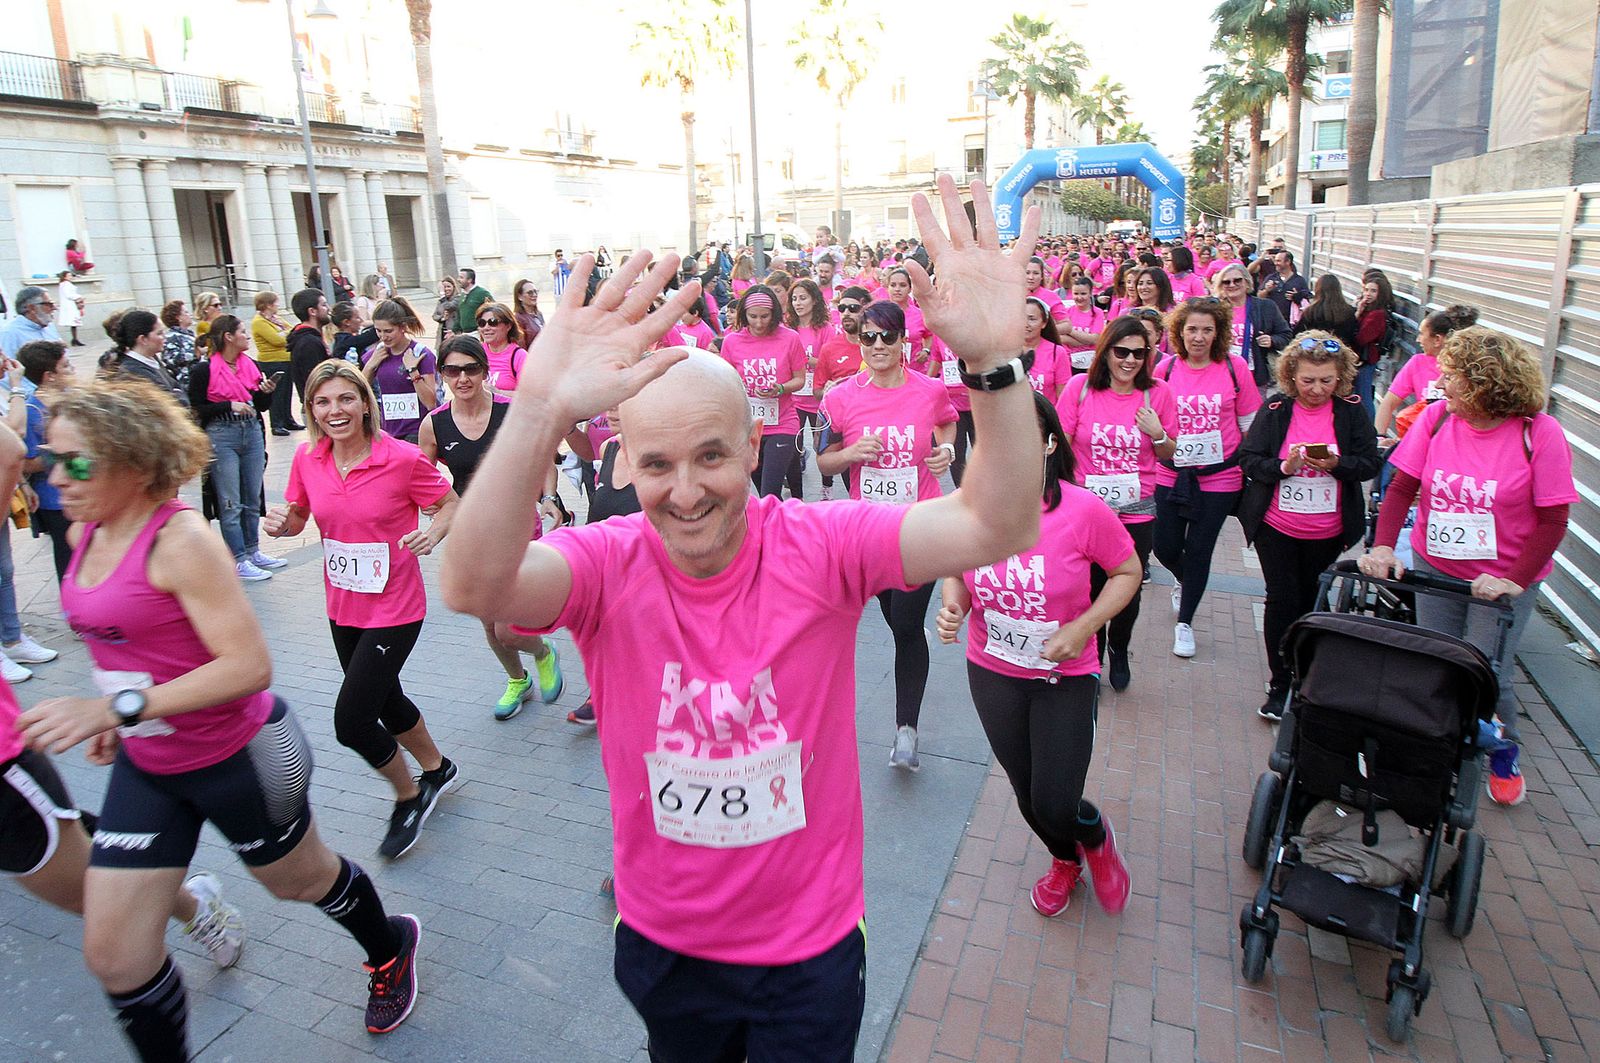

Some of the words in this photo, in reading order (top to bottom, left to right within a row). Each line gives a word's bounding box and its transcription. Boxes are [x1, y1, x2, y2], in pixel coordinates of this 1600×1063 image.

[277, 141, 361, 157] AYUNAMIENTO
[1004, 163, 1033, 192] DEPORTES
[1079, 167, 1118, 176] HUELVA
[1139, 157, 1171, 186] DEPORTES
[743, 357, 777, 376] KM
[384, 401, 406, 412] 270
[1177, 393, 1222, 415] KM
[1178, 414, 1220, 429] POR
[1091, 422, 1142, 448] KM
[864, 451, 913, 469] OR
[1091, 445, 1140, 462] POR
[1175, 442, 1205, 458] 692
[863, 479, 897, 496] 548
[1281, 485, 1313, 502] 361
[1430, 469, 1498, 508] KM
[1428, 523, 1466, 544] 362
[328, 553, 358, 576] 691
[974, 586, 1047, 614] POR
[990, 623, 1029, 650] 547
[657, 661, 778, 742] KM
[671, 762, 719, 779] Carrera
[724, 768, 740, 779] de
[658, 779, 750, 820] 678
